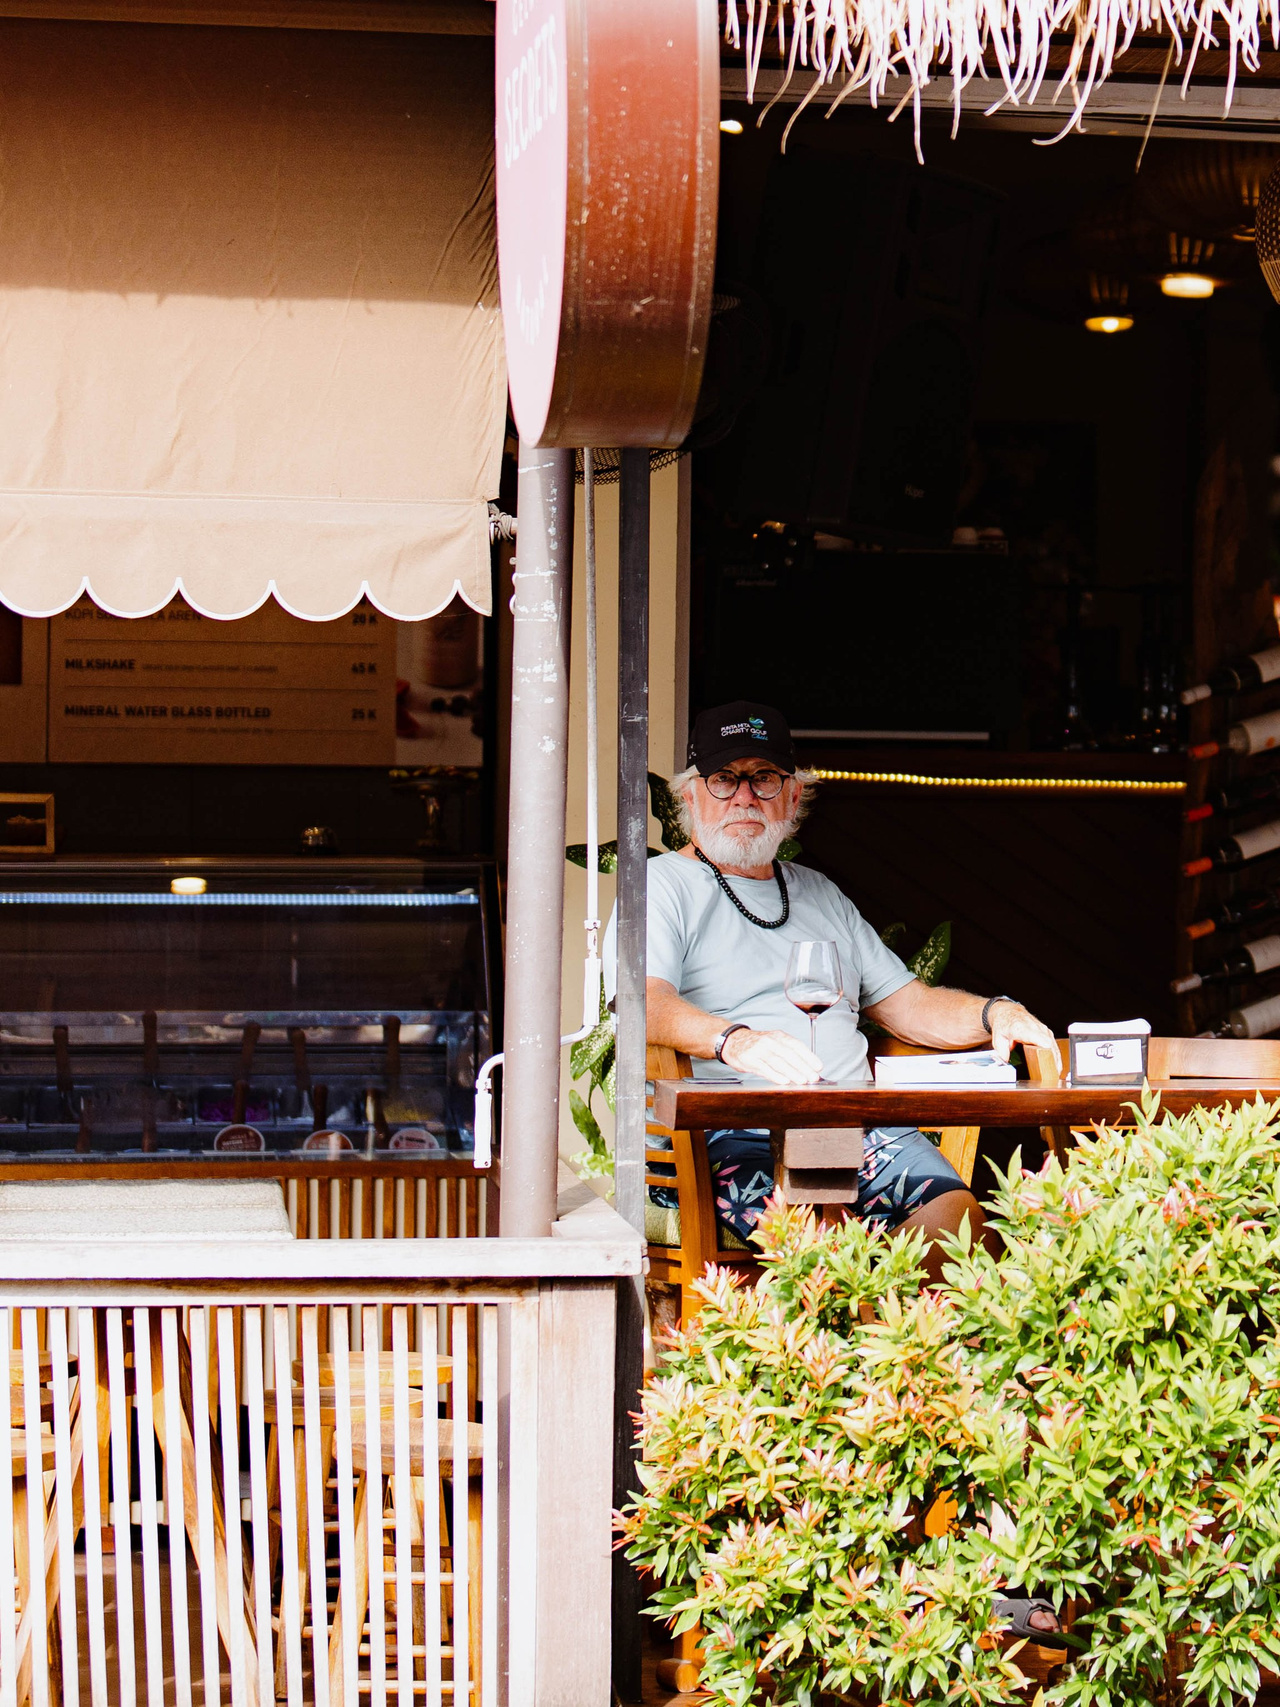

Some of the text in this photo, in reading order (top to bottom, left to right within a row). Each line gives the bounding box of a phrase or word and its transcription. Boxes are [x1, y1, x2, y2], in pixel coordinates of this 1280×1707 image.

[505, 14, 558, 169] SECRETS
[64, 658, 136, 671] MILKSHAKE
[368, 662, 377, 674] K
[64, 704, 377, 721] MINERAL WATER GLASS BOTTLED 25 K
